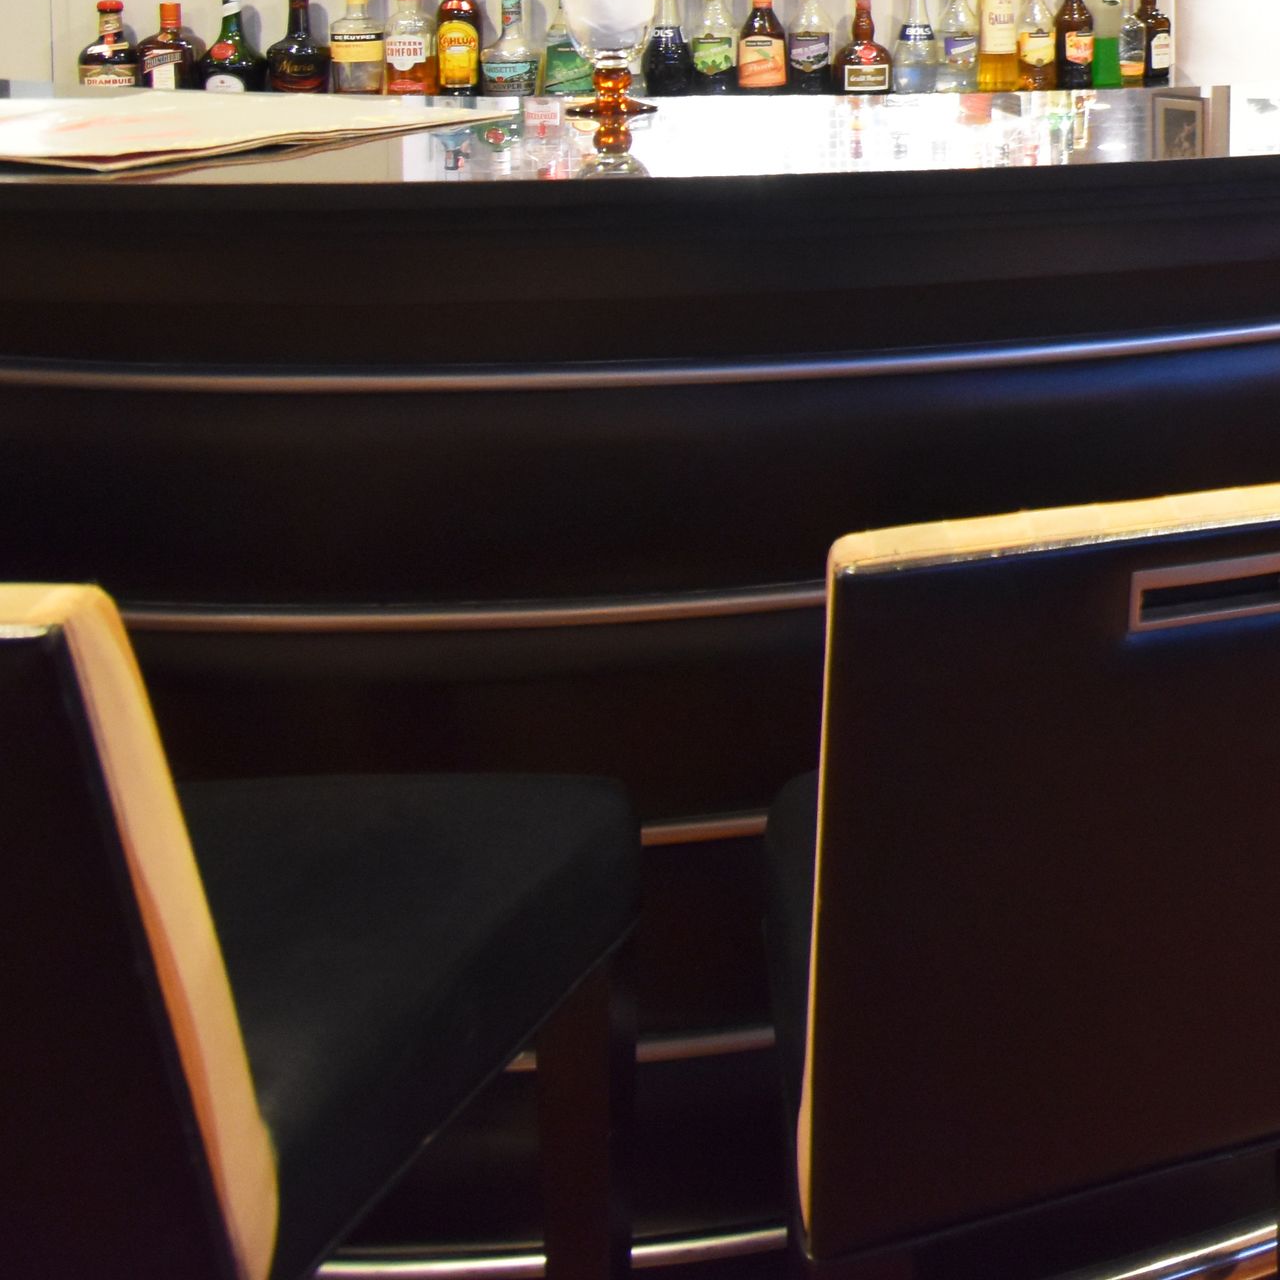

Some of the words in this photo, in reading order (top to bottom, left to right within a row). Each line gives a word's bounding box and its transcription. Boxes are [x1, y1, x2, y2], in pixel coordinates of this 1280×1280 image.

[905, 27, 931, 35] BOLS
[387, 47, 423, 57] COMFORT
[87, 78, 132, 86] DRAMBUIE
